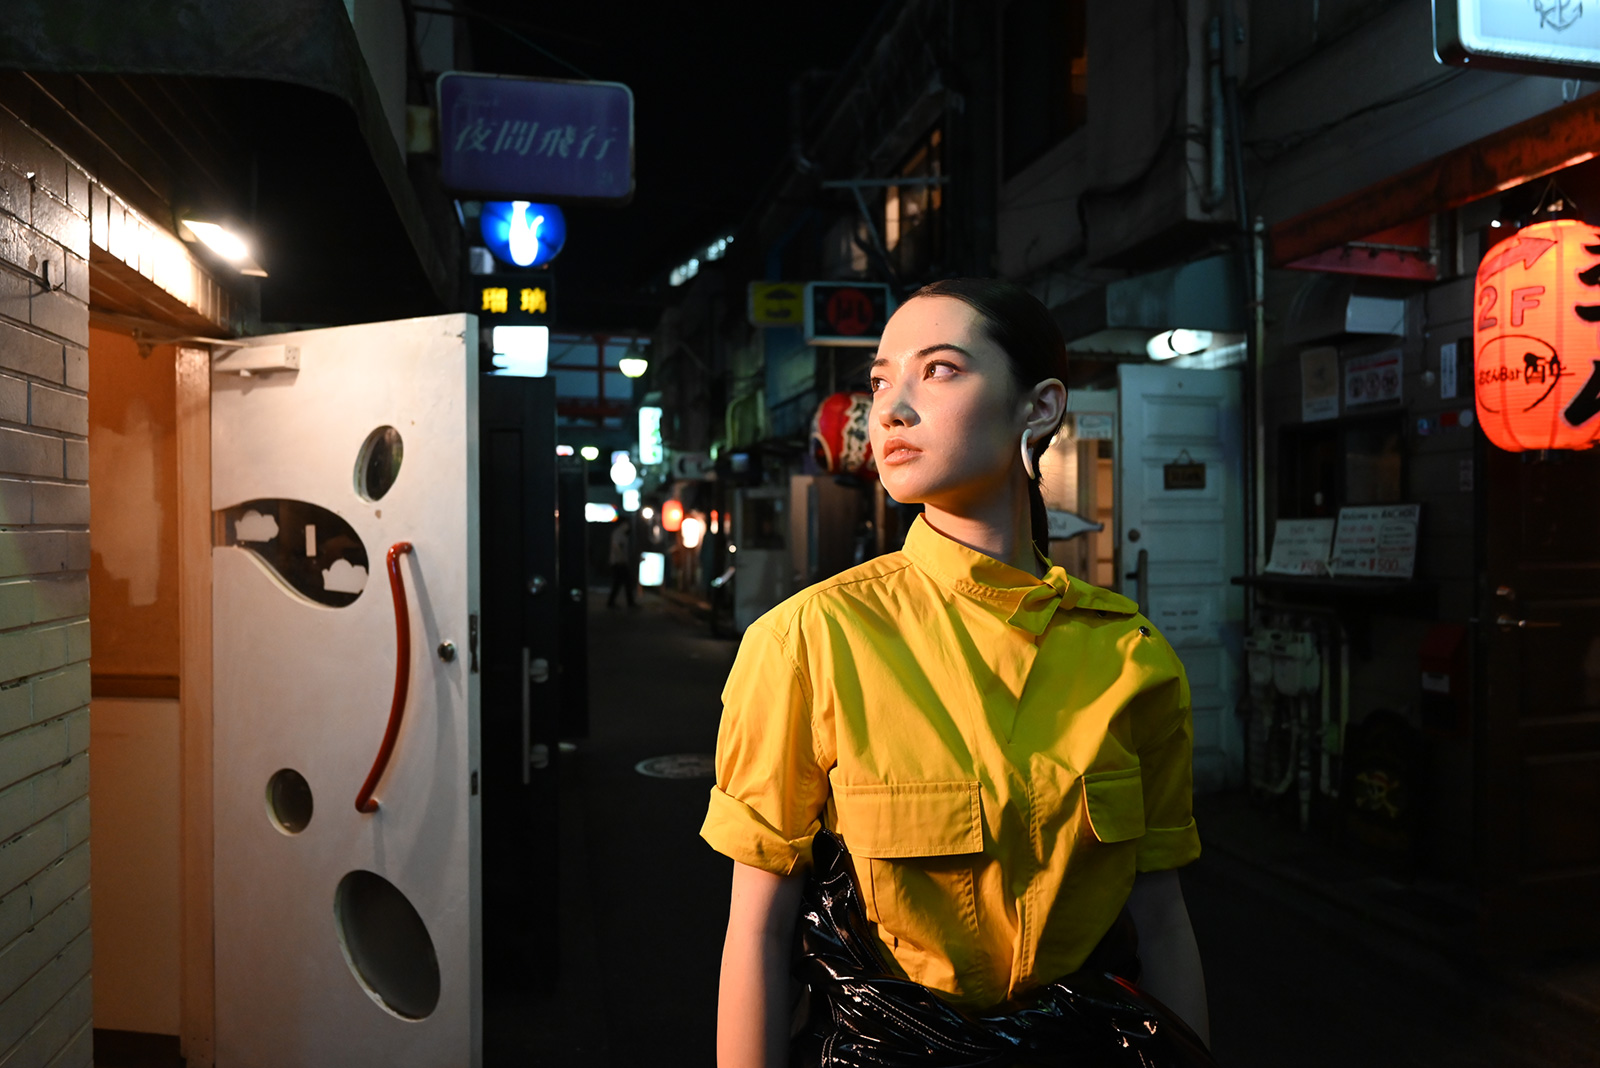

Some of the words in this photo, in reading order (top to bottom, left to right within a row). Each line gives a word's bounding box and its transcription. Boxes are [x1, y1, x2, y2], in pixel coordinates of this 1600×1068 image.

[454, 117, 618, 161] 夜間飛行
[1477, 285, 1546, 332] 2F
